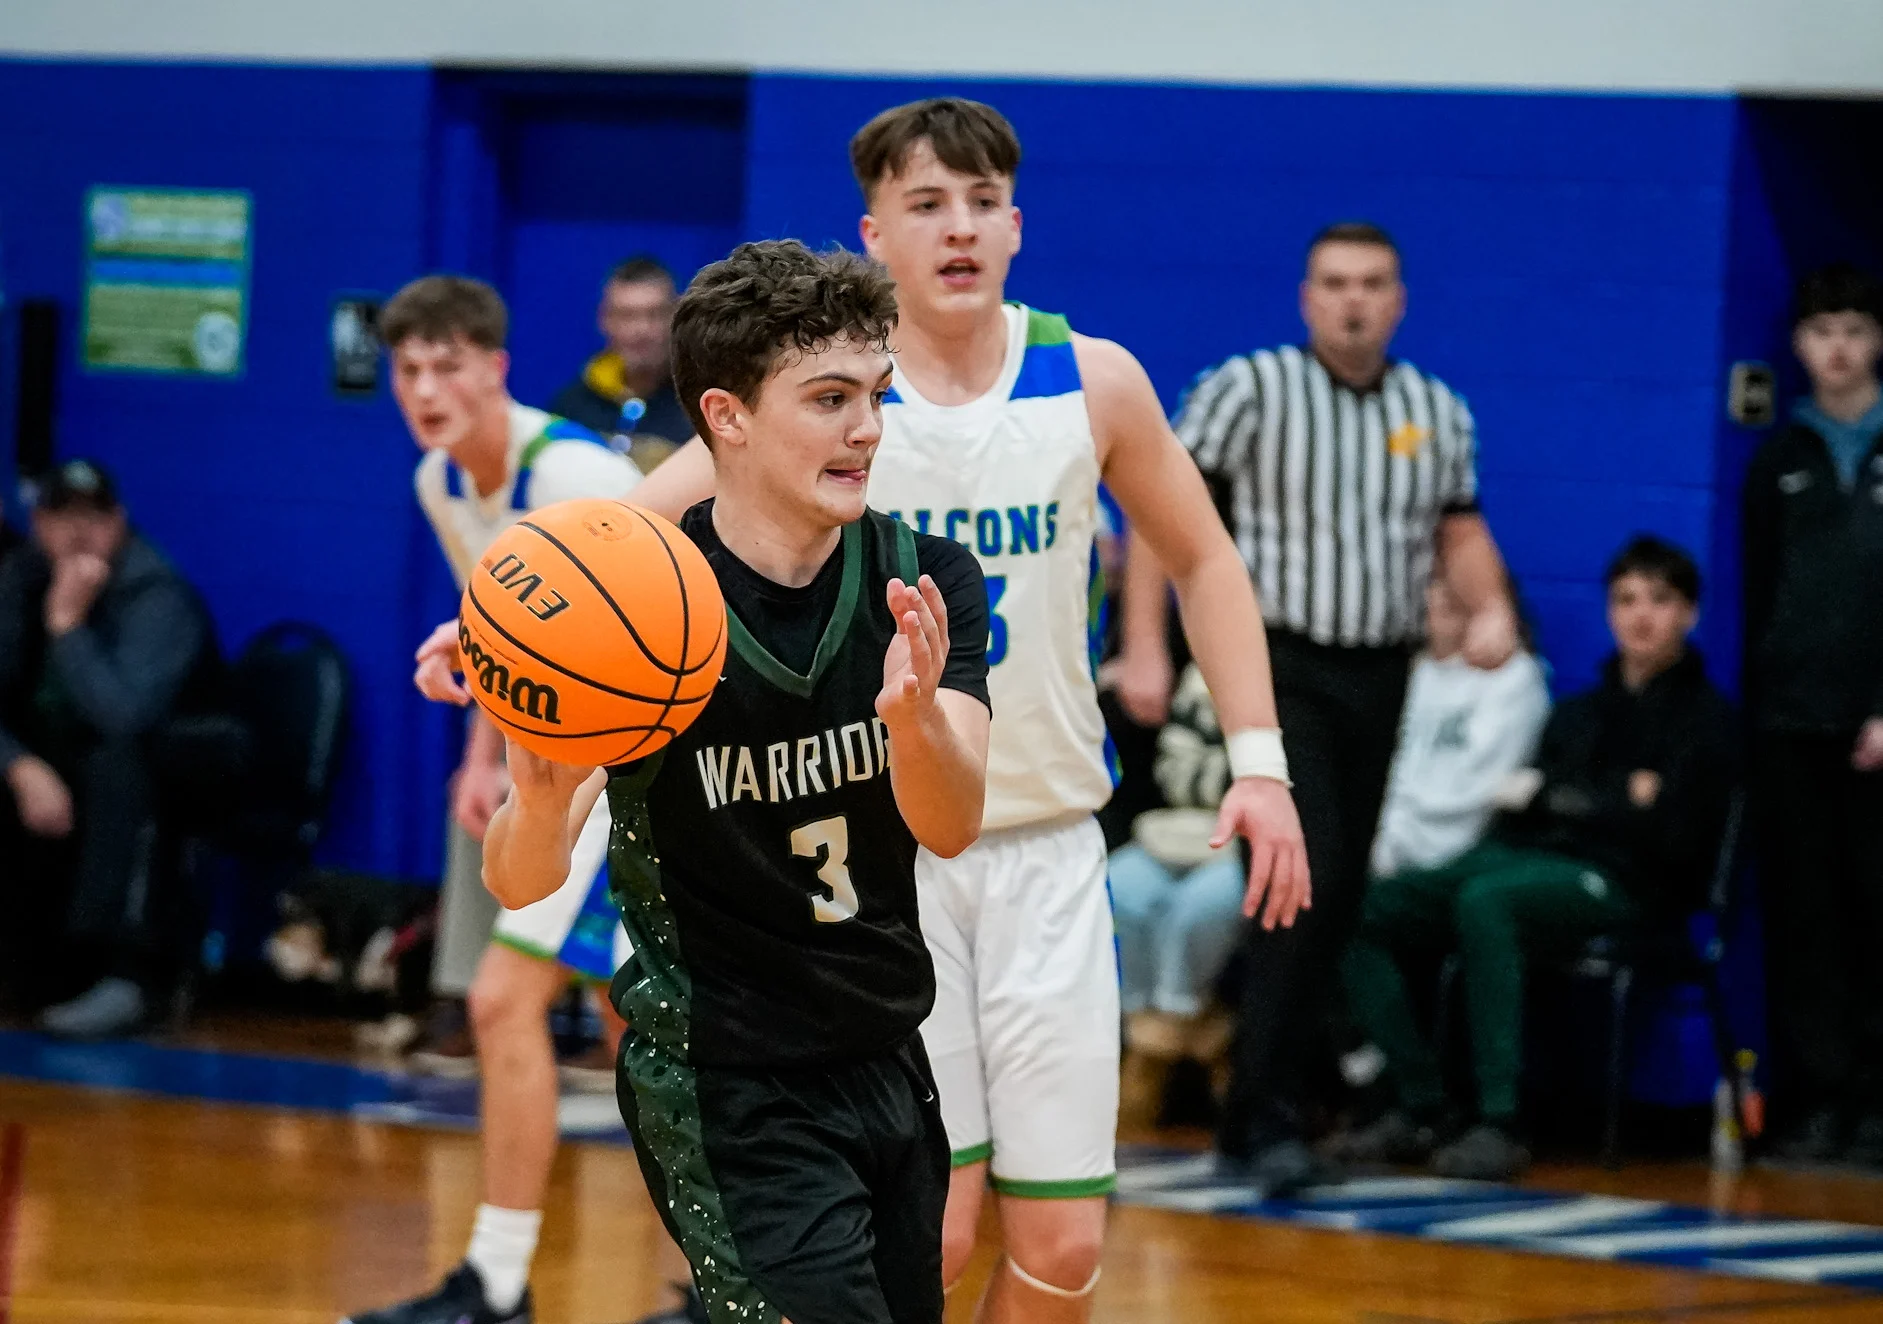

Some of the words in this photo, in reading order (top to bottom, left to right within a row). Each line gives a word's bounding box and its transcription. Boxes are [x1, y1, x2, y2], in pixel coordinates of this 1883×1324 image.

[888, 500, 1060, 557] CONS
[489, 553, 571, 621] EVO
[459, 613, 562, 725] Wilso
[696, 716, 892, 810] WARRIOR
[790, 815, 860, 923] 3
